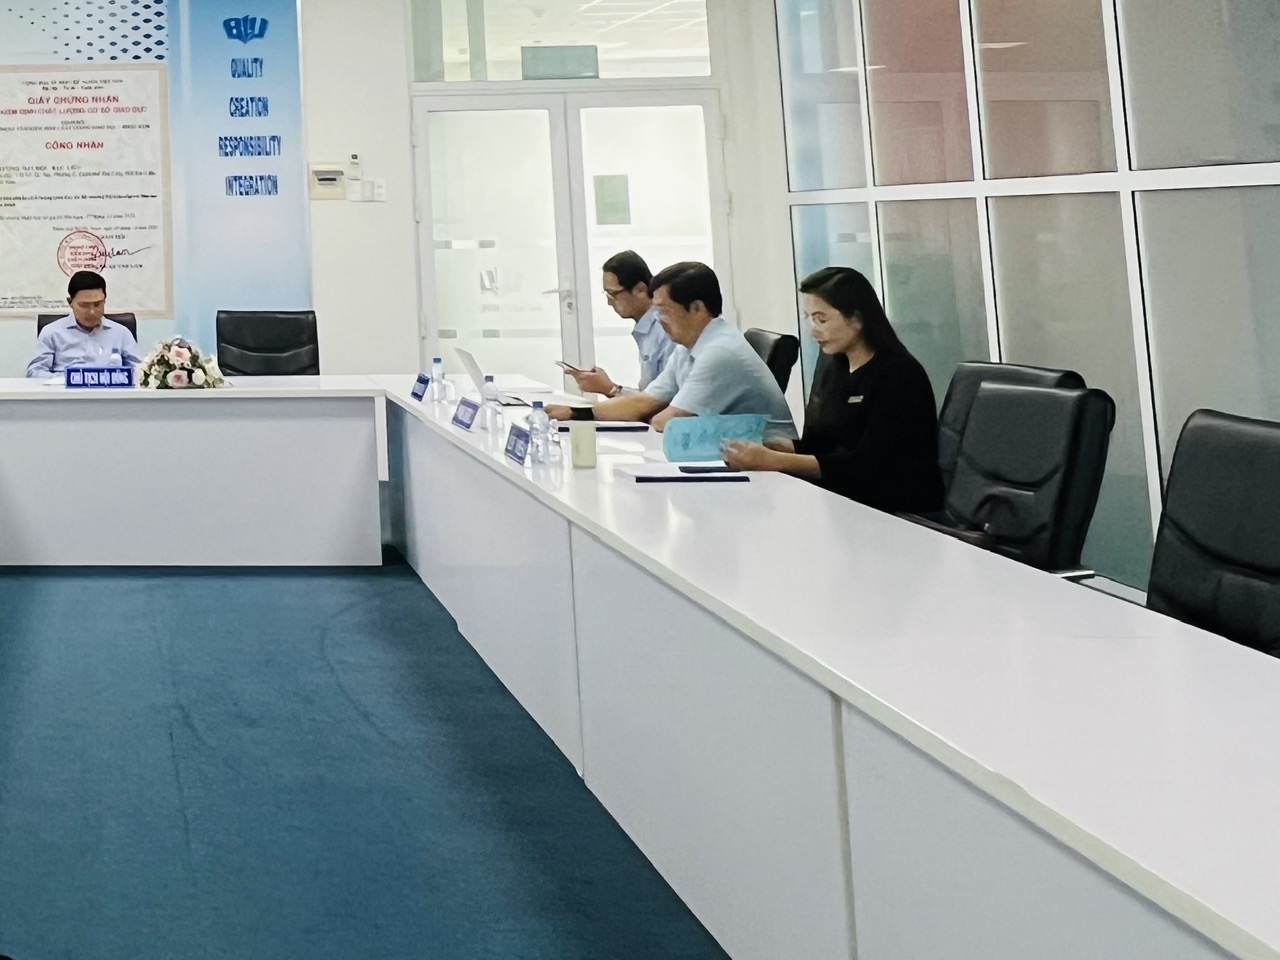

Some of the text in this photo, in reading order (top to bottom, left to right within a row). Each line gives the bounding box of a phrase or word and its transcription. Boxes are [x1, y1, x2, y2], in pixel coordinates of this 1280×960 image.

[222, 15, 269, 44] BLU
[231, 58, 264, 78] QUALITY
[229, 96, 269, 117] CREATION
[45, 140, 74, 150] CÔNG
[218, 136, 281, 157] RESPONSIBILITY
[225, 175, 278, 196] INTEGRATION
